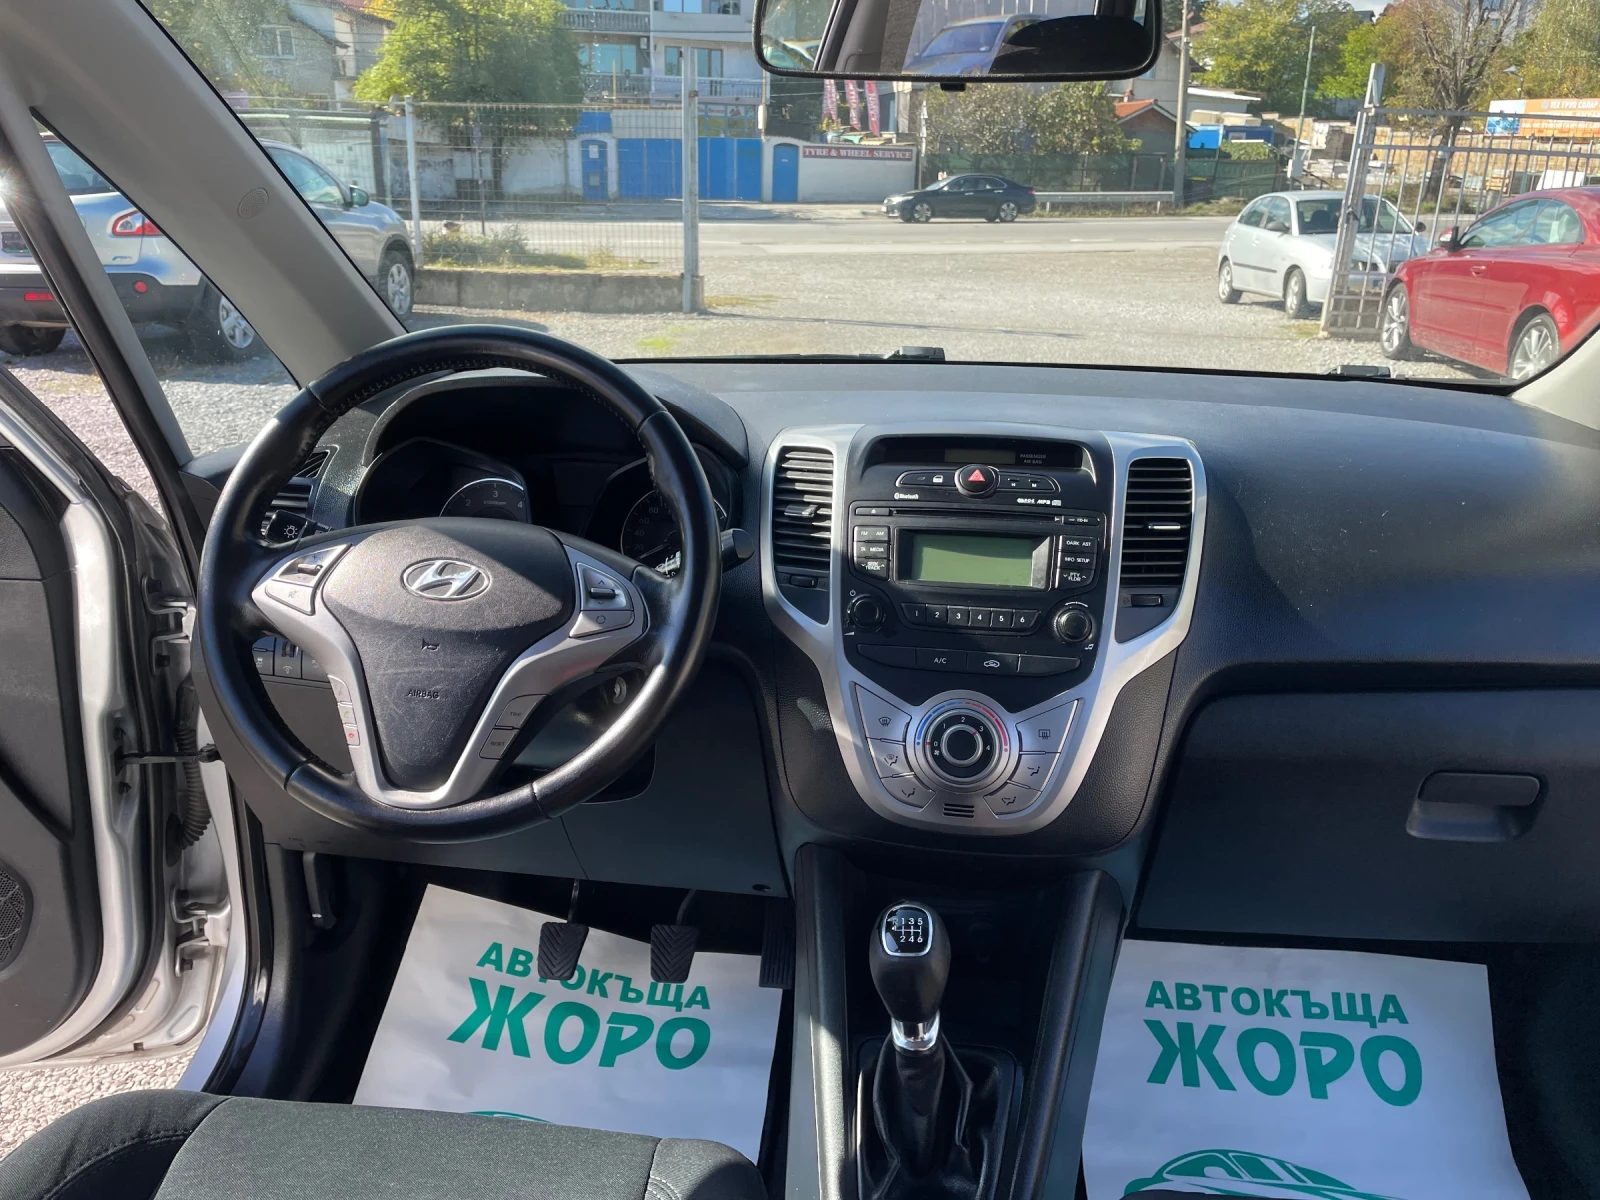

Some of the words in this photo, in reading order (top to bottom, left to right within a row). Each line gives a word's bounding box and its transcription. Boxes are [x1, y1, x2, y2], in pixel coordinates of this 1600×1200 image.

[805, 148, 828, 156] TYRE
[830, 148, 838, 156] &
[840, 149, 872, 158] WHEEL
[874, 150, 912, 158] SERVICE
[406, 690, 440, 699] AIRBAG
[476, 942, 710, 1012] АВОКЪЩА
[1144, 980, 1410, 1029] АВТОКЪЩА
[447, 977, 711, 1070] ЖОРО
[1143, 1019, 1423, 1107] ЖОРО
